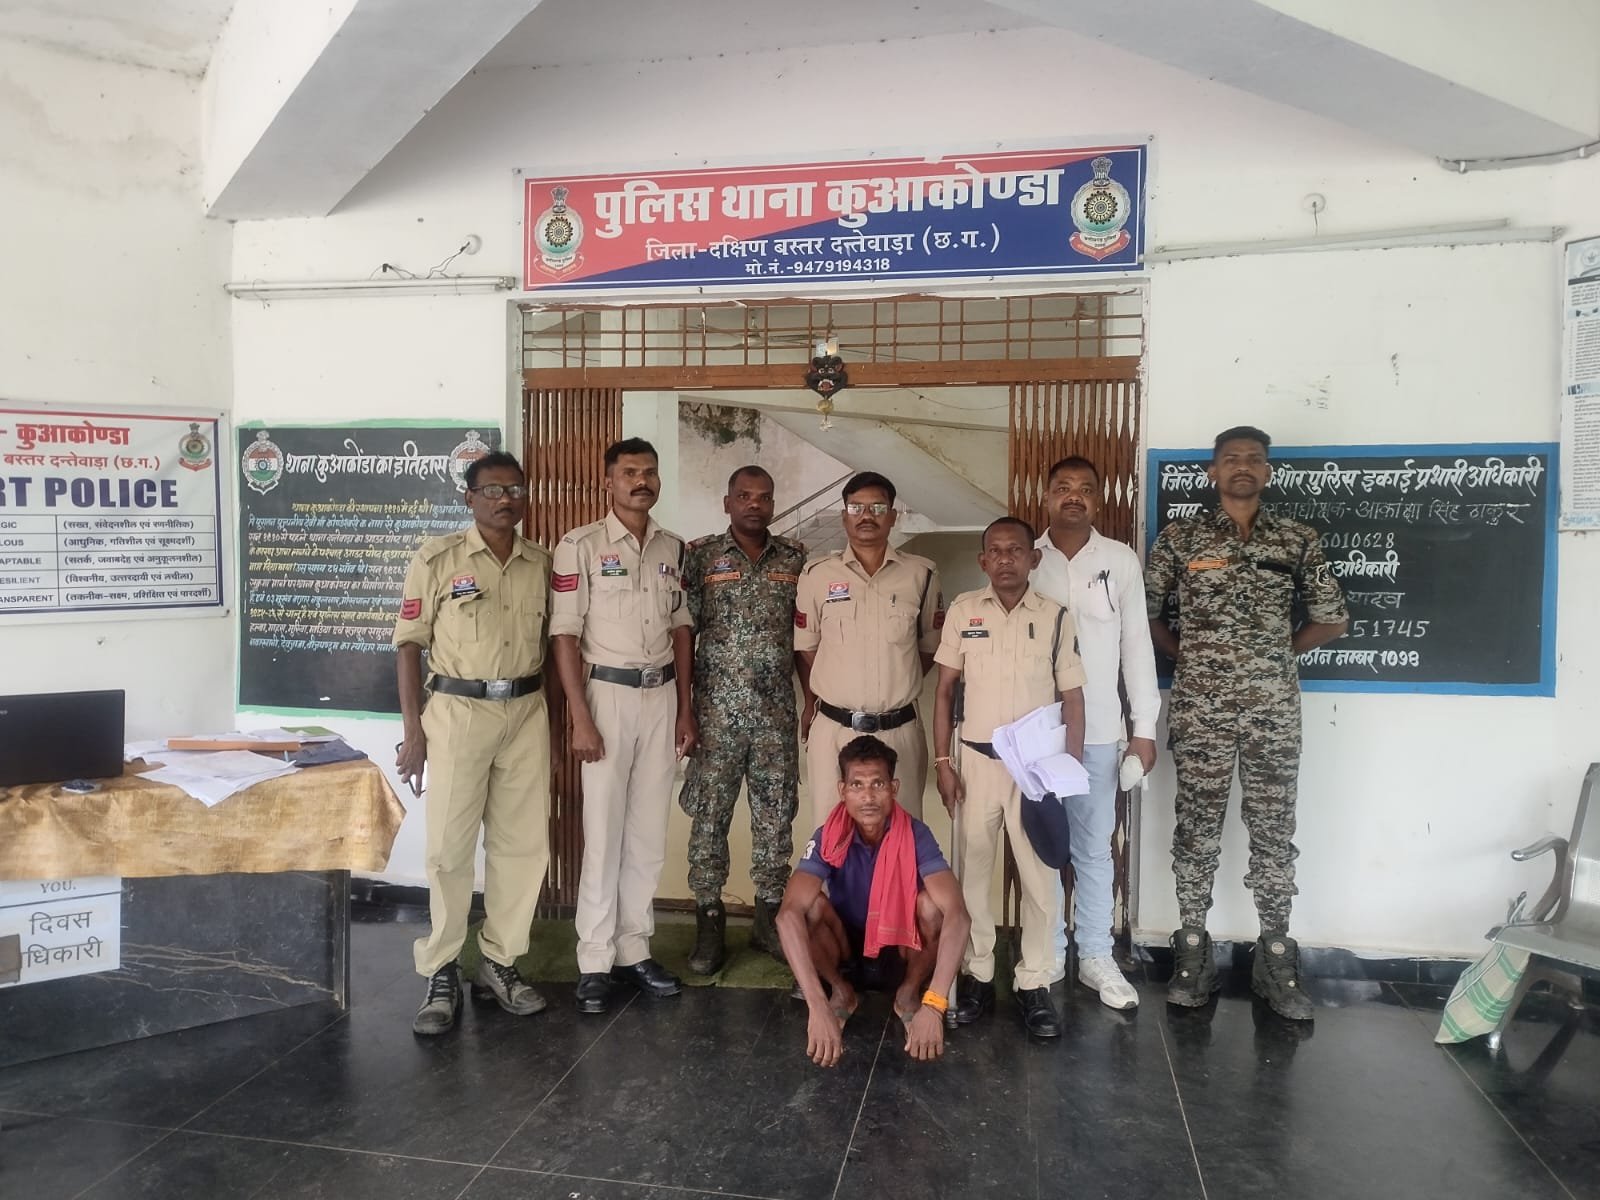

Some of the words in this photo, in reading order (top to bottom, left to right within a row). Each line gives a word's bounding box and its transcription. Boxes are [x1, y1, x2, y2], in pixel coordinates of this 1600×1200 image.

[593, 180, 714, 239] पुलिस
[721, 182, 817, 219] थाना
[825, 163, 1065, 229] कुआकोण्डा
[645, 235, 768, 261] जिला-दक्षिण
[774, 237, 825, 257] बस्तर
[922, 223, 1000, 256] (छ.ग.)
[16, 420, 130, 450] कुआकोण्डा
[4, 453, 45, 466] बस्तर
[50, 451, 108, 470] दन्तेवाड़ा
[114, 455, 160, 471] (छ.ग.)
[286, 453, 316, 473] थाना
[376, 454, 393, 474] का
[393, 440, 449, 483] इतिहास
[1307, 461, 1361, 496] पुलिस
[1361, 459, 1416, 494] इकाई
[1415, 458, 1468, 497] प्रभारी
[1466, 455, 1544, 497] अधिकारी
[45, 477, 178, 508] POLICE
[139, 519, 150, 530] एवं
[145, 535, 155, 546] एवं
[134, 553, 144, 563] एवं
[1332, 549, 1400, 583] अधिकारी
[151, 571, 162, 582] एवं
[167, 588, 178, 598] एवं
[1340, 620, 1430, 638] 51745
[1336, 649, 1378, 673] नम्बर
[28, 911, 93, 936] दिवस
[22, 936, 103, 968] धिकारी
